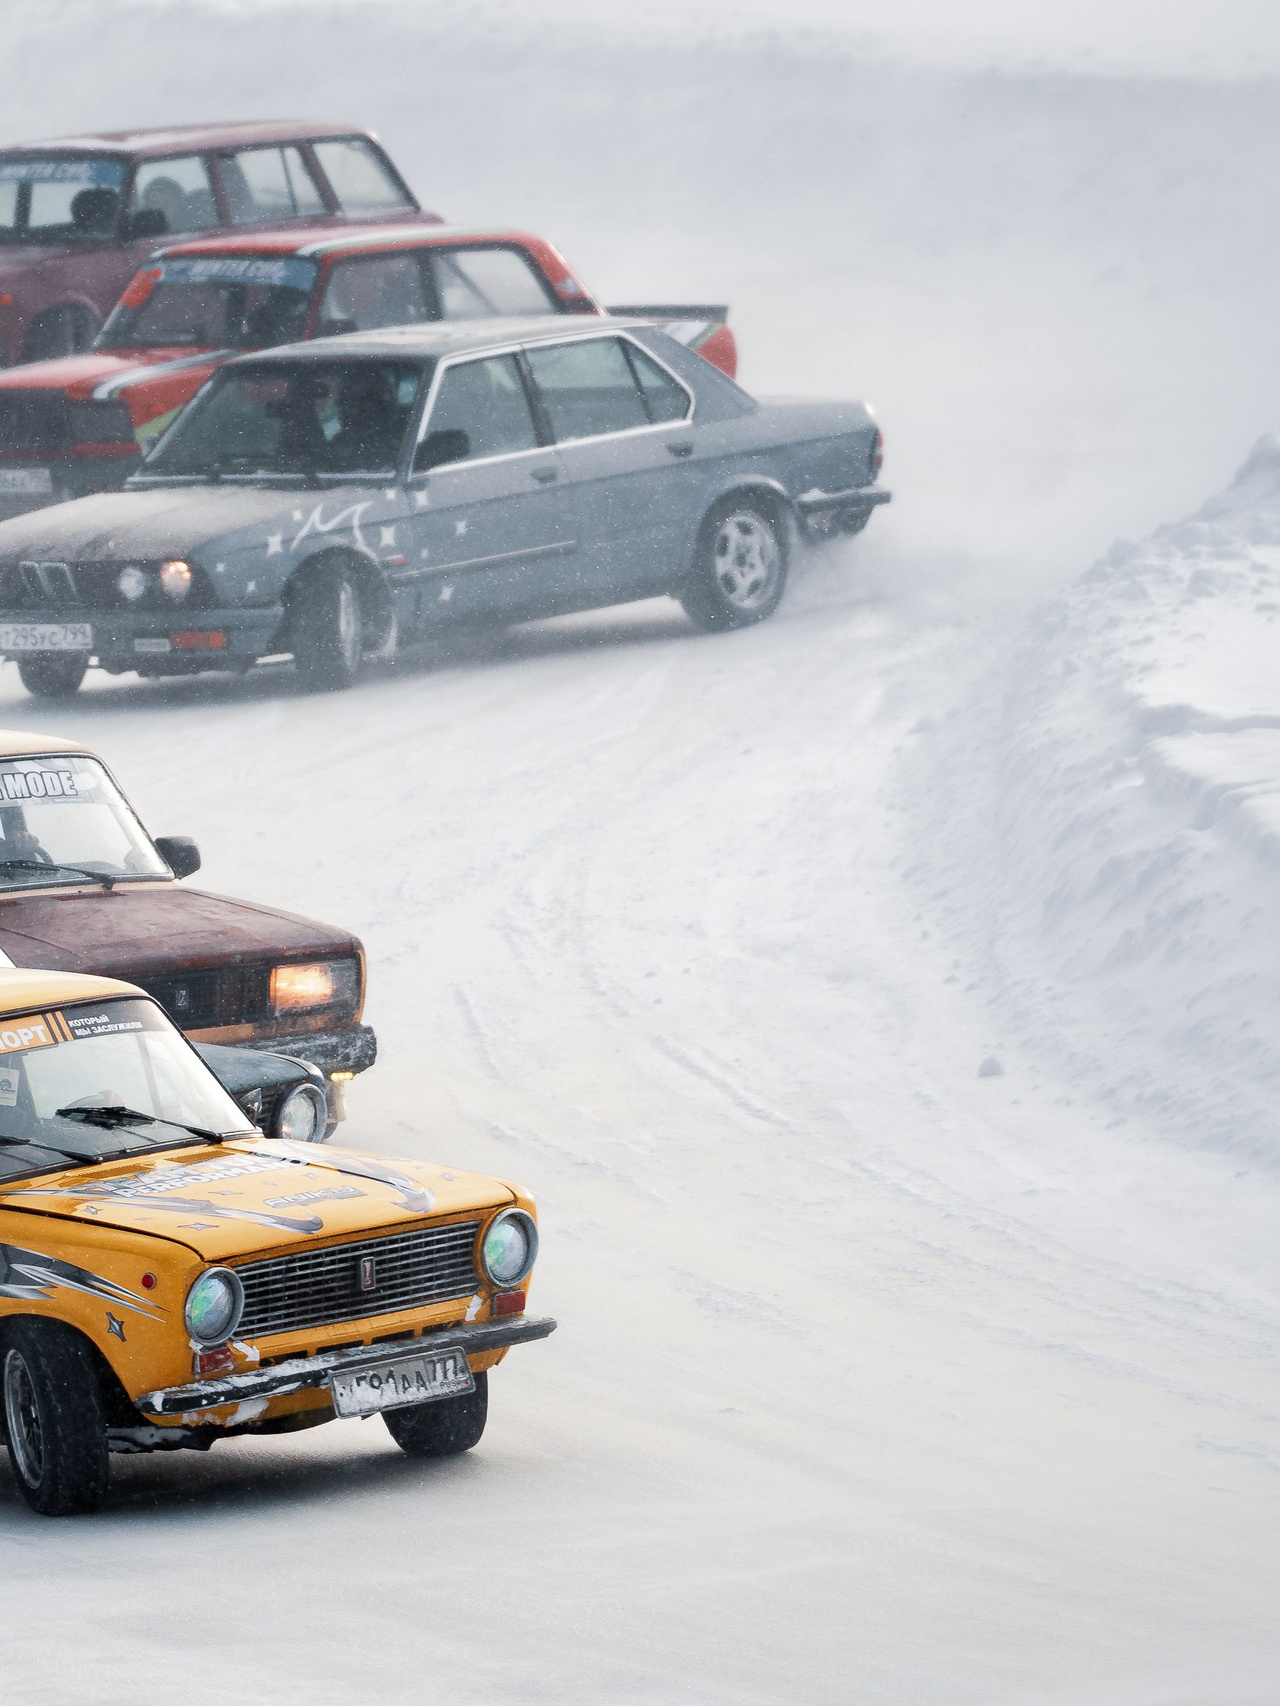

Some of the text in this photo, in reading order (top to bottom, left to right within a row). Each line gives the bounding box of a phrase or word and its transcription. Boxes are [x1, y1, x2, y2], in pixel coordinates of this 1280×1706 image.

[2, 770, 77, 799] MODE
[67, 1013, 110, 1028] КОТОРЫЙ
[92, 1021, 144, 1034] ЗАСЛУЖИЛИ
